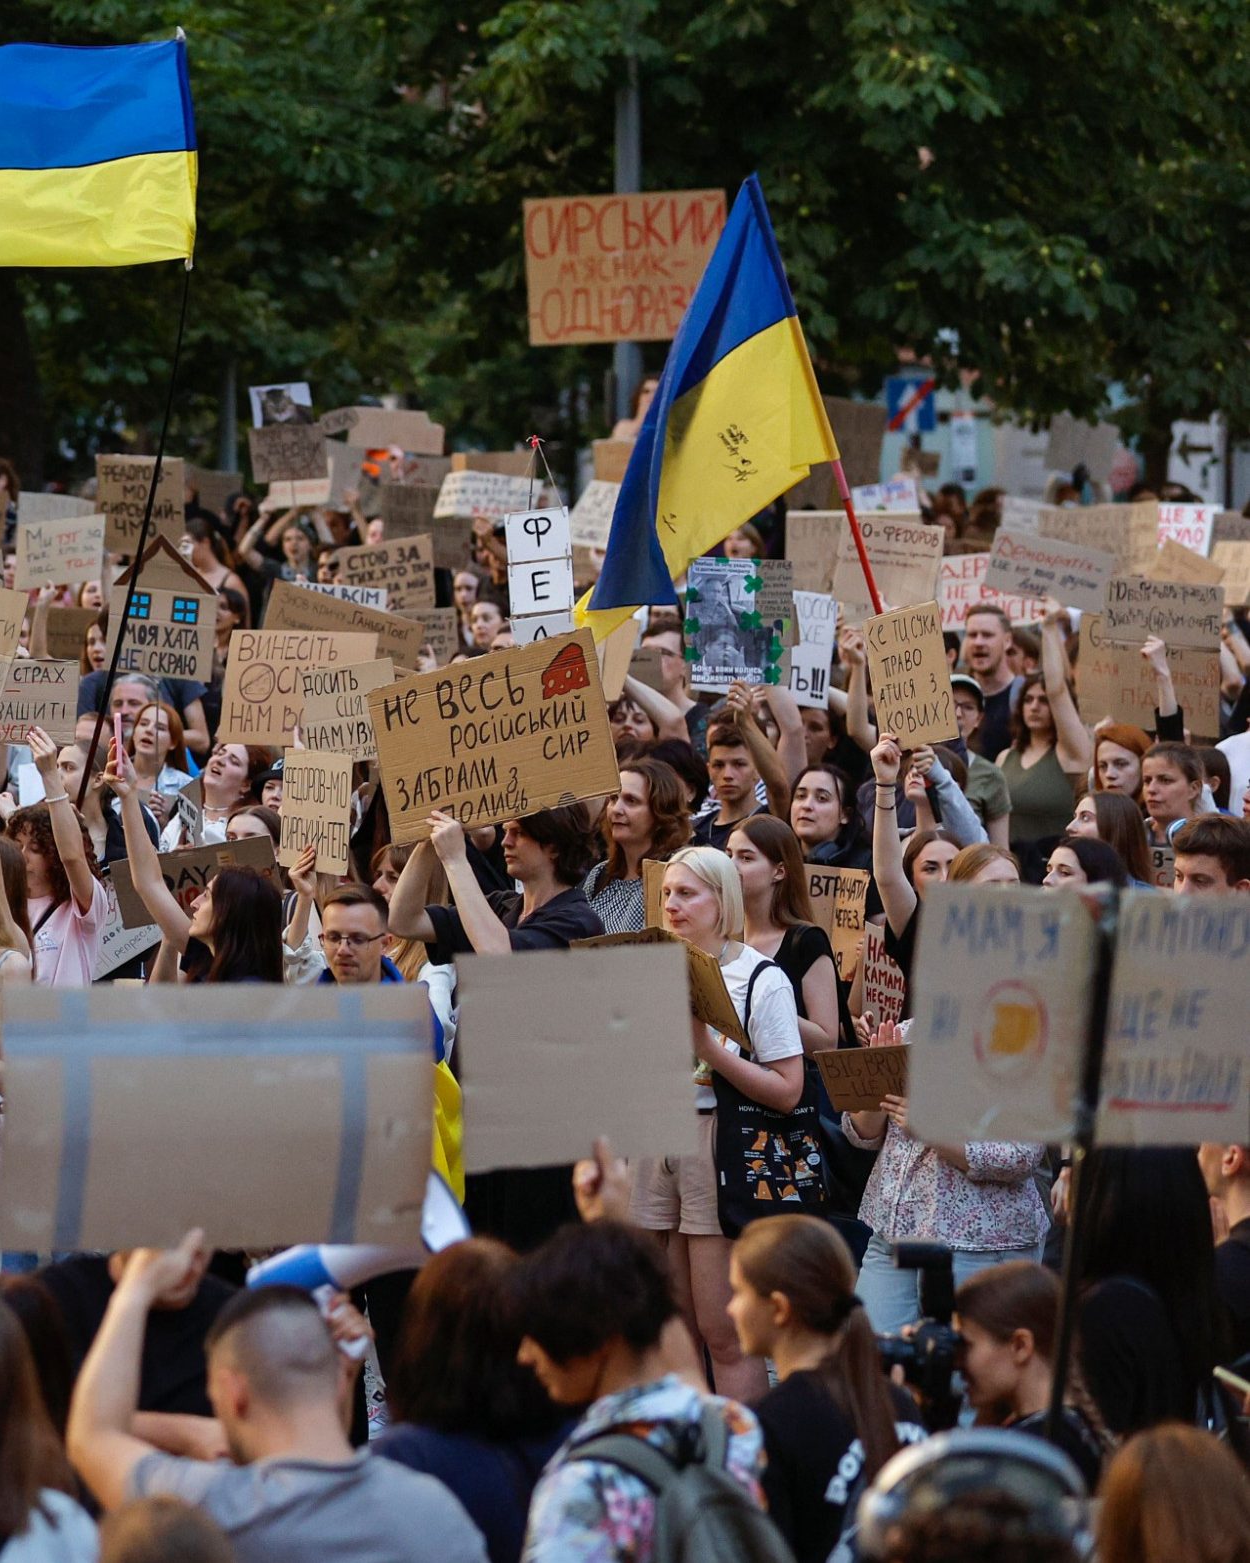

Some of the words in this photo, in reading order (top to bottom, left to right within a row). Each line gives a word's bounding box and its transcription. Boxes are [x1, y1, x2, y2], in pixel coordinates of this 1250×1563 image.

[525, 198, 726, 260] СИРСЬКИЙ
[530, 284, 698, 340] -ОДНОРАЗ
[348, 550, 389, 570] СТОЮ
[397, 546, 421, 564] ЗА
[341, 587, 381, 605] ВСІМ
[163, 627, 200, 651] ХАТА
[238, 633, 339, 662] ВИНЕСІТЬ
[14, 666, 66, 684] СТРАХ
[118, 648, 142, 672] НЕ
[149, 651, 197, 676] СКРАЮ
[882, 648, 923, 675] ПРАВО
[303, 669, 358, 699] ДОСИТЬ
[879, 680, 917, 708] АТИСЯ
[229, 701, 273, 734] НАМ
[384, 688, 421, 732] НЕ
[884, 691, 951, 734] КОВИХ?
[306, 724, 343, 751] НАМ
[449, 695, 586, 758] РОСІЙСЬКИЙ
[543, 729, 590, 761] СИР
[396, 755, 498, 812] ЗАБРАЛИ
[506, 766, 519, 794] З
[810, 874, 866, 901] ВТРАЧАТИ
[835, 908, 860, 931] ЧЕРЕЗ
[794, 1106, 809, 1116] DAY
